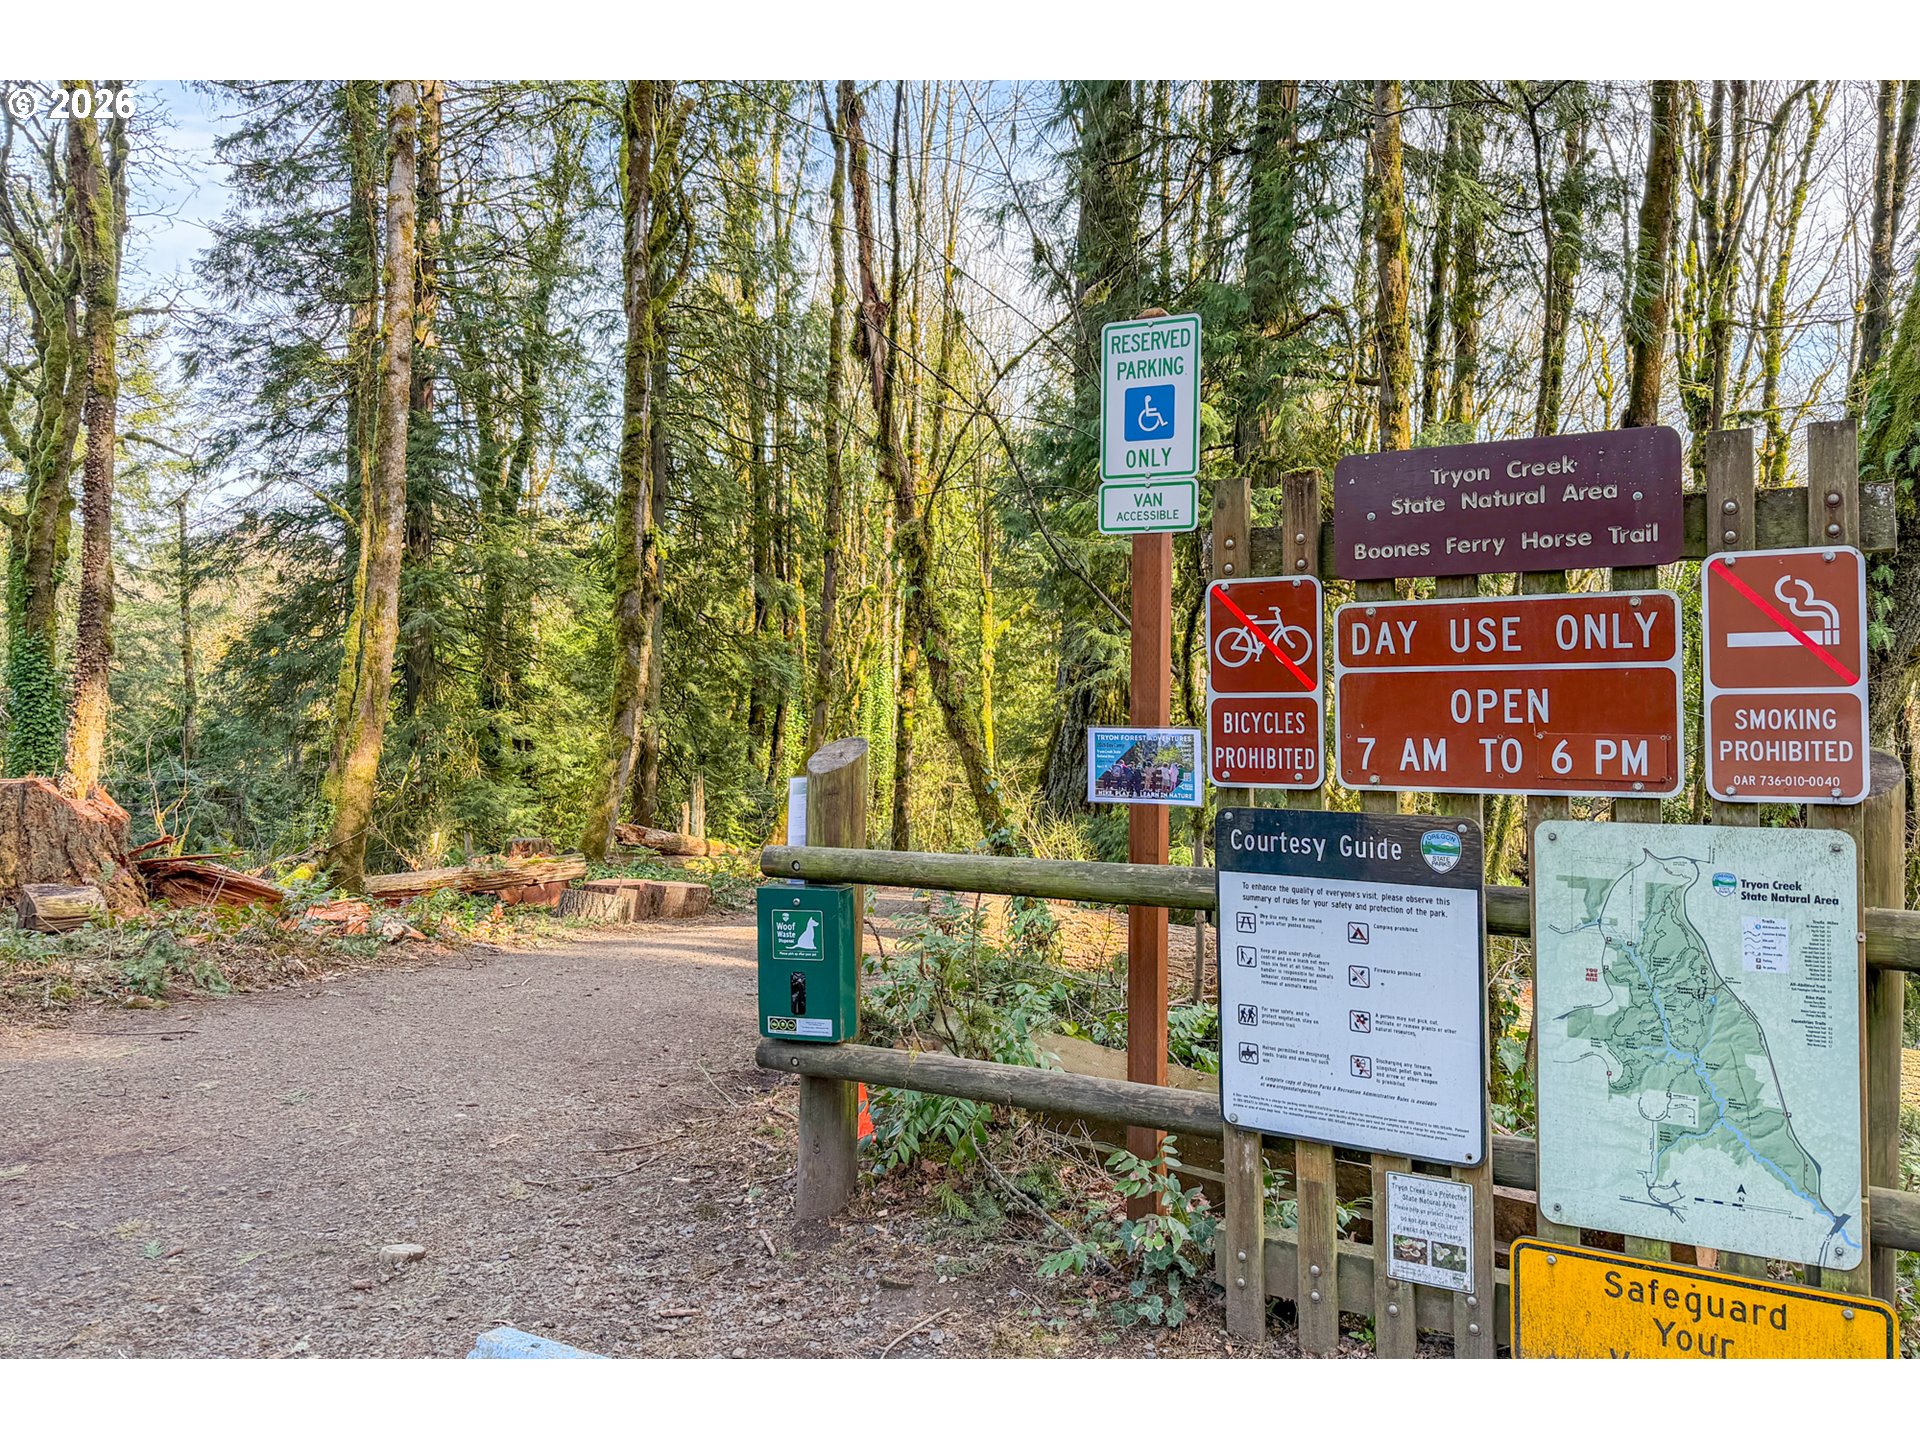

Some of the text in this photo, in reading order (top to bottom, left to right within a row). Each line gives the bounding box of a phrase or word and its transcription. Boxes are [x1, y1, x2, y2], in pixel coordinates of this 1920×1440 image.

[1111, 328, 1191, 354] RESERVED
[1117, 356, 1184, 380] PARKING
[1126, 447, 1171, 468] ONLY
[1430, 455, 1576, 488] Tryon Creek
[1134, 493, 1163, 507] VAN
[1391, 483, 1618, 516] State Natural Area
[1116, 509, 1179, 522] ACCESSIBLE
[1354, 523, 1658, 560] Boones Ferry Horse Trail
[1351, 611, 1658, 656] DAY USE ONLY
[1450, 688, 1550, 724] OPEN
[1223, 712, 1305, 734] BICYCLES
[1734, 708, 1837, 730] SMOKING
[1215, 747, 1315, 770] PROHIBITED
[1357, 737, 1648, 776] 7 AM TO 6 PM
[1719, 740, 1853, 762] PROHIBITED
[1733, 775, 1840, 787] OAR 736-010-0040
[1230, 828, 1402, 862] Courtesy Guide
[1426, 833, 1456, 843] OREGON
[1242, 881, 1249, 890] To
[1251, 883, 1276, 891] enhance
[1291, 886, 1314, 896] quality
[1325, 889, 1360, 899] everyone's
[1381, 893, 1403, 902] please
[1406, 895, 1433, 904] observe
[1436, 897, 1450, 906] this
[1740, 879, 1802, 891] Tryon Creek
[1243, 894, 1271, 904] summary
[1283, 897, 1298, 905] rules
[1301, 898, 1310, 906] for
[1313, 900, 1328, 908] your
[1331, 900, 1352, 911] safety
[1355, 903, 1367, 911] and
[1369, 904, 1403, 914] protection
[1406, 907, 1413, 915] of
[1416, 908, 1427, 916] the
[1430, 910, 1448, 919] park.
[1741, 891, 1839, 905] State Natural Area
[776, 922, 796, 930] Woof
[1392, 1182, 1408, 1192] Tryon
[1409, 1186, 1425, 1195] Creek
[1439, 1190, 1467, 1202] Protected
[1402, 1194, 1456, 1209] State Natural Area
[1604, 1270, 1787, 1331] Safeguard
[1652, 1317, 1735, 1359] Your
